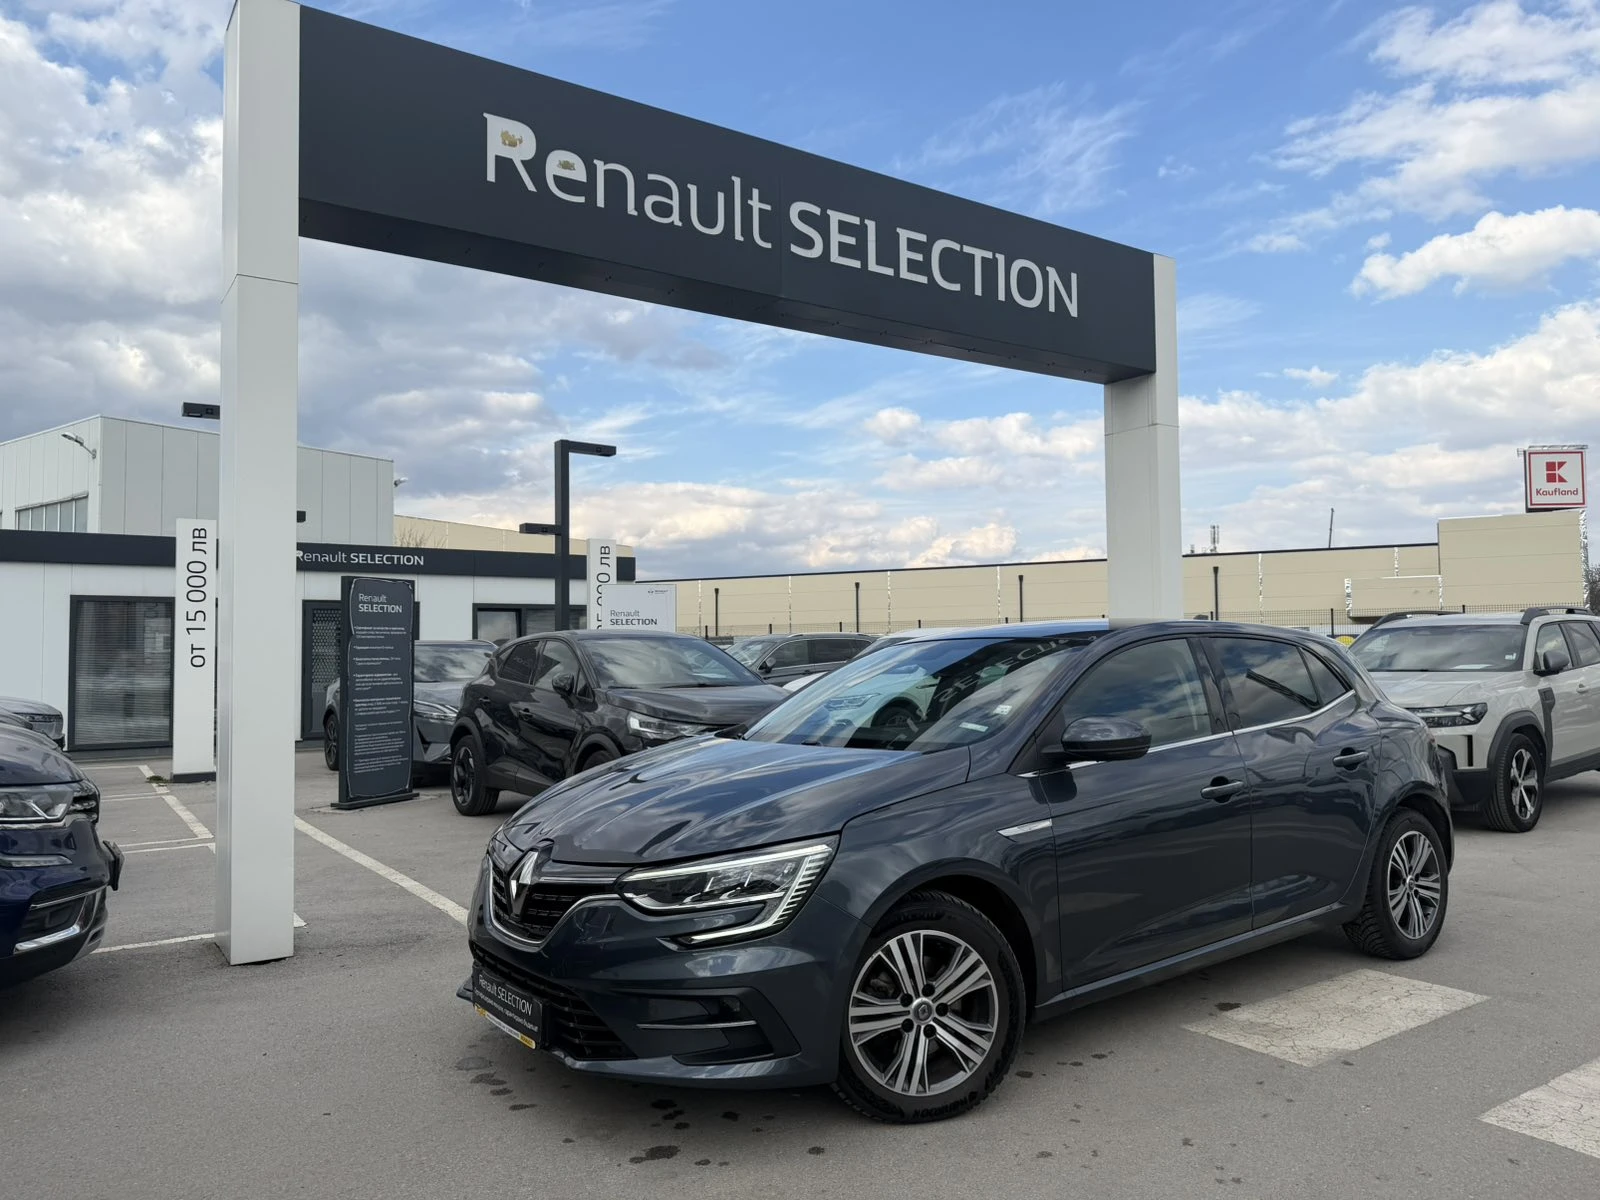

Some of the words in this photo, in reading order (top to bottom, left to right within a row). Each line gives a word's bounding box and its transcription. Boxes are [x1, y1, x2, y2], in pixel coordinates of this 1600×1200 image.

[483, 113, 772, 249] Renault
[789, 201, 1078, 318] SELECTION
[1535, 488, 1579, 496] Kaufland
[350, 553, 424, 565] SELECTION
[186, 560, 207, 602] 000
[358, 593, 387, 603] Renault
[358, 603, 403, 613] SELECTION
[186, 610, 207, 635] 15
[610, 618, 658, 626] SELECTION
[497, 986, 533, 1016] SELECTION
